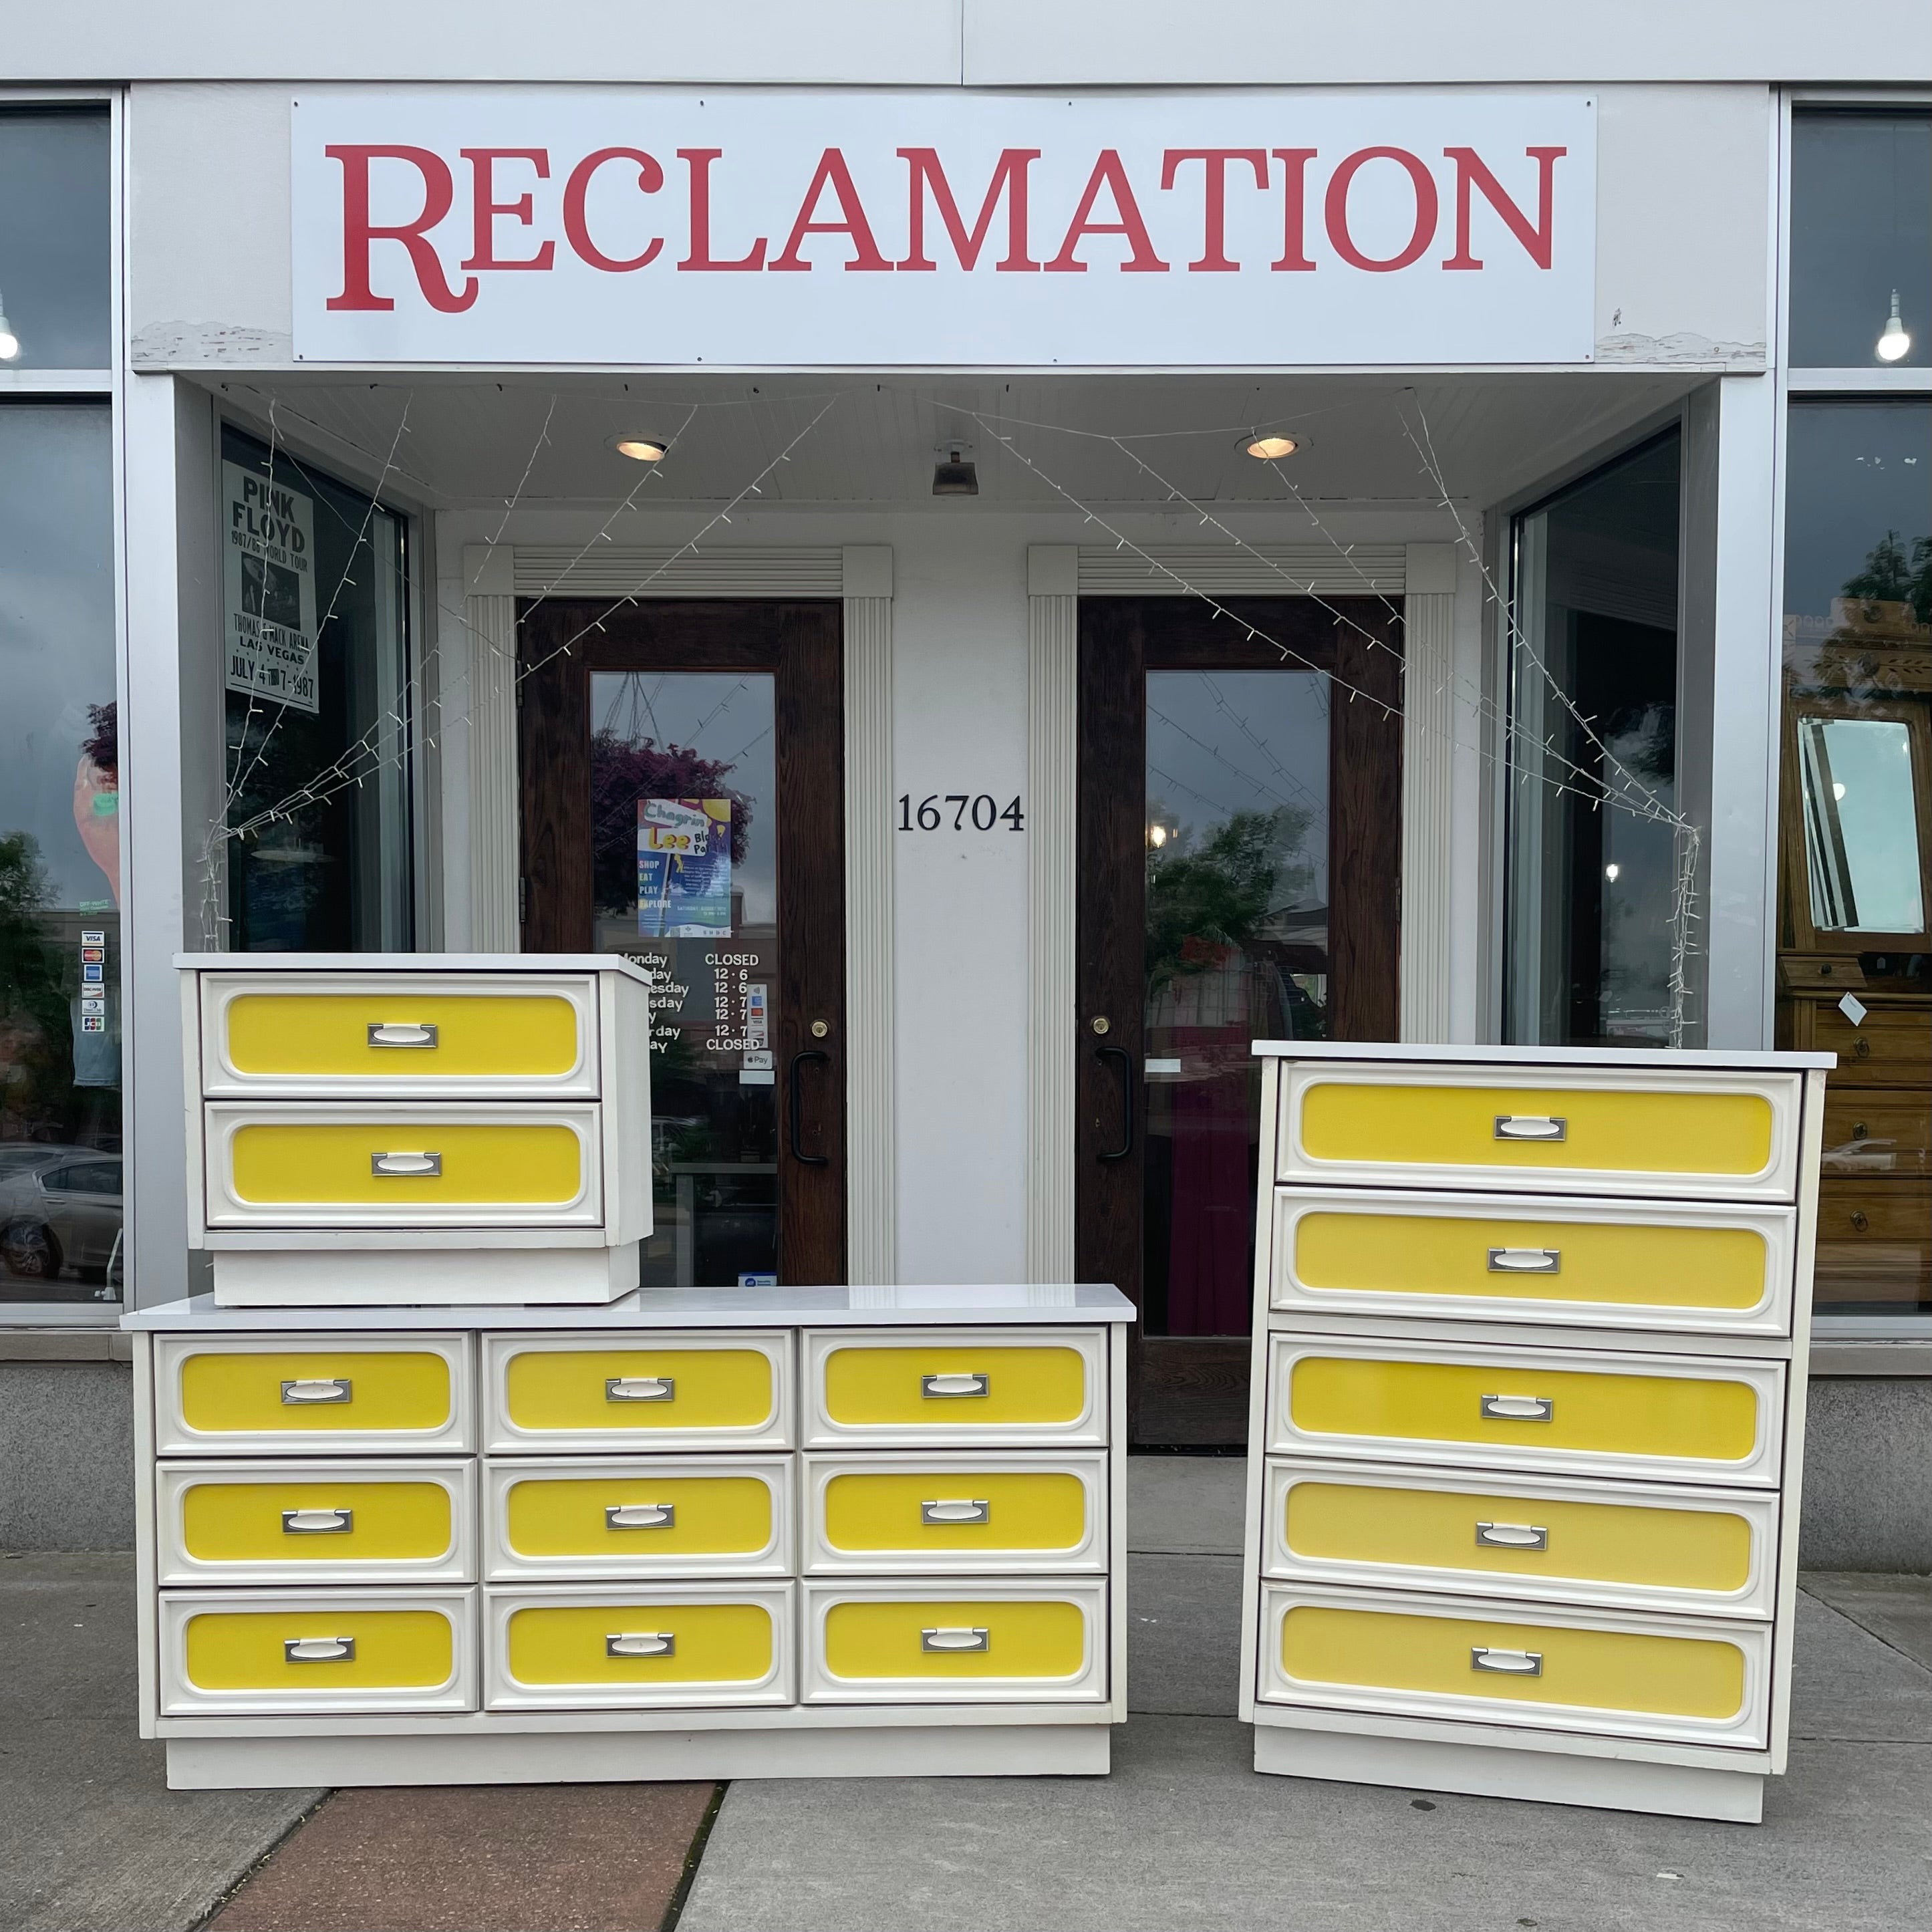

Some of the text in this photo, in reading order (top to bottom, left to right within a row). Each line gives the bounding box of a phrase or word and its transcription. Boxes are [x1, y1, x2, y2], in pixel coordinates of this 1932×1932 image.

[326, 146, 1566, 313] RECLAMATION
[244, 476, 295, 523] PINK
[233, 501, 305, 553] FLOYD
[290, 553, 307, 573] TOUR
[234, 613, 259, 638] THOMAS
[269, 625, 286, 647] MACK
[241, 636, 304, 665] LAS VEGAS
[231, 655, 255, 680] JULY
[644, 803, 704, 827] Chagrin
[898, 794, 1024, 831] 16704
[649, 827, 691, 849] Lee
[639, 861, 660, 869] SHOP
[639, 873, 653, 881] EAT
[640, 886, 658, 894] PLAY
[640, 900, 672, 908] EXPLORE
[705, 954, 759, 966] CLOSED
[706, 1039, 760, 1051] CLOSED
[754, 1056, 768, 1065] Pay
